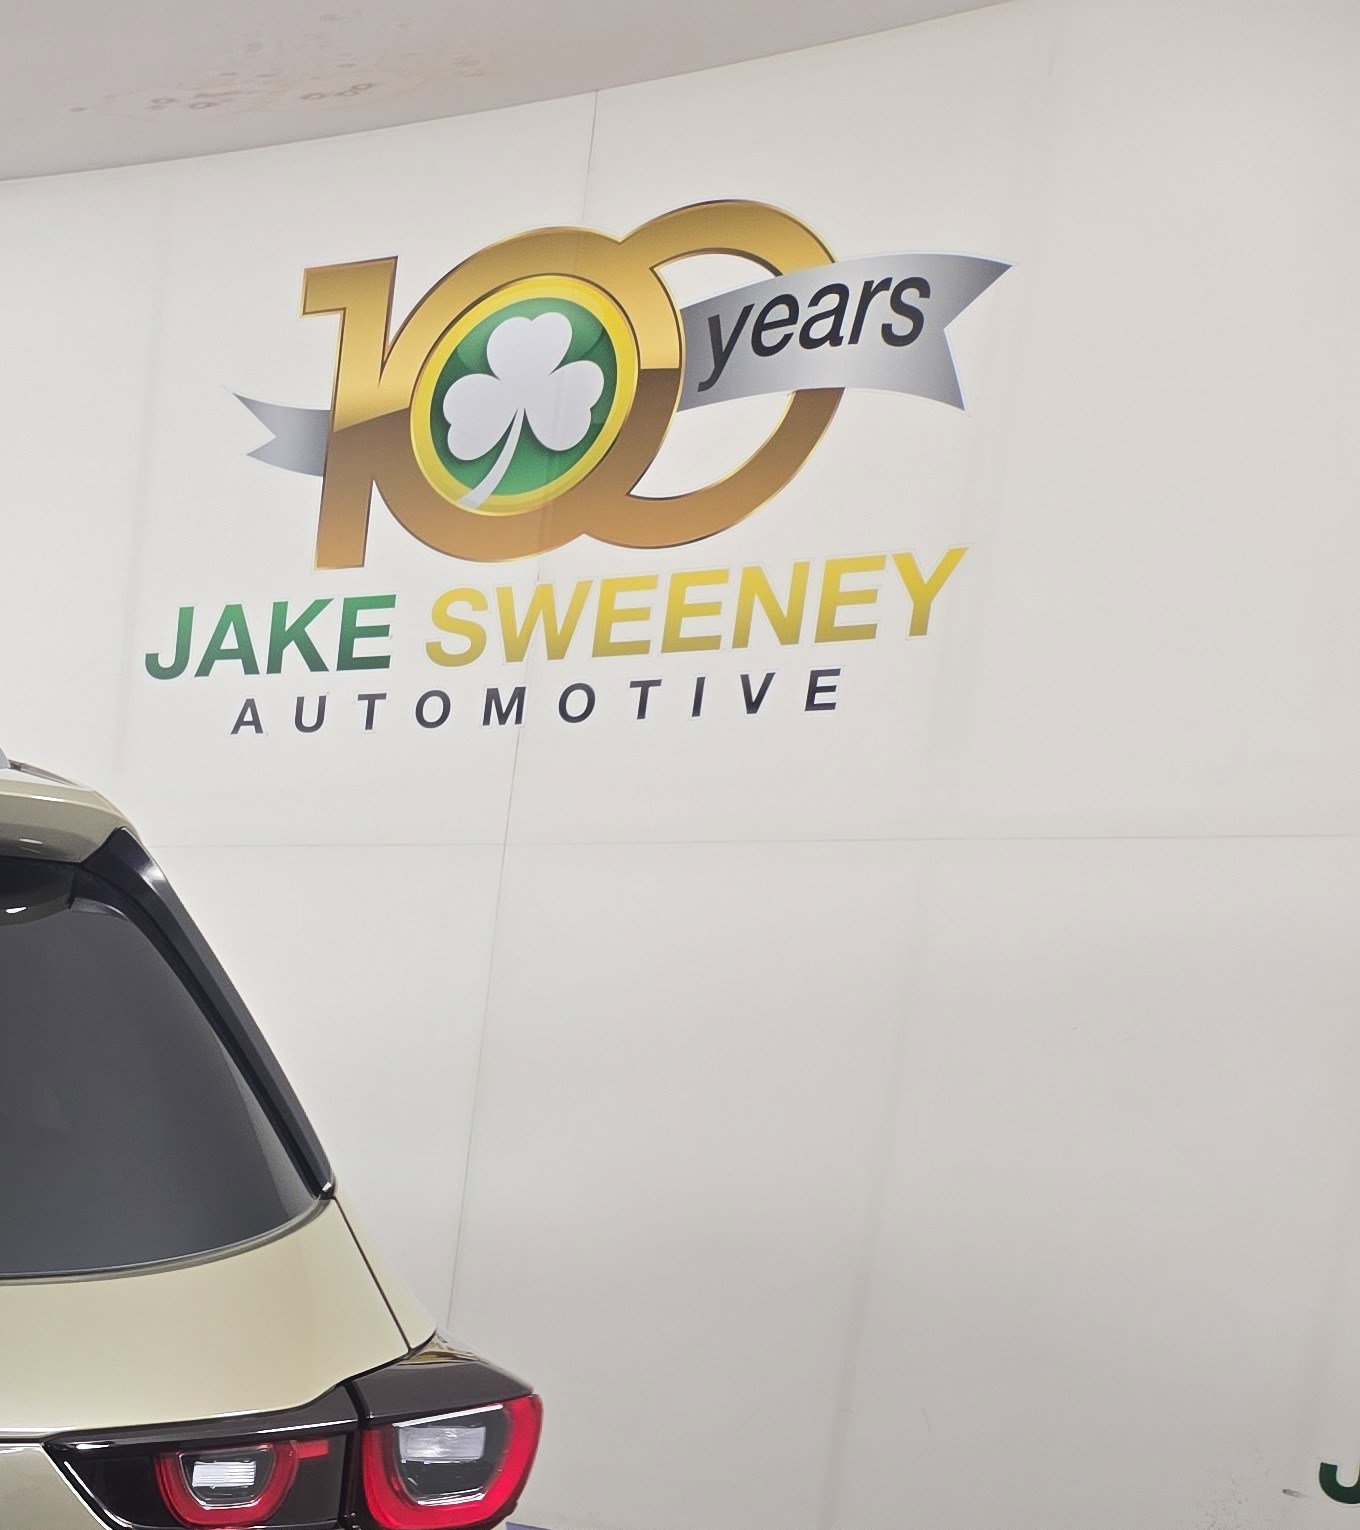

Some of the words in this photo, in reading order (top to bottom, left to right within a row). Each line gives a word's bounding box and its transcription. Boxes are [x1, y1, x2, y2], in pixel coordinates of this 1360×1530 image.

[696, 271, 931, 393] years
[145, 594, 398, 682] JAKE
[425, 547, 970, 669] SWEENEY
[231, 668, 842, 736] AUTOMOTIVE
